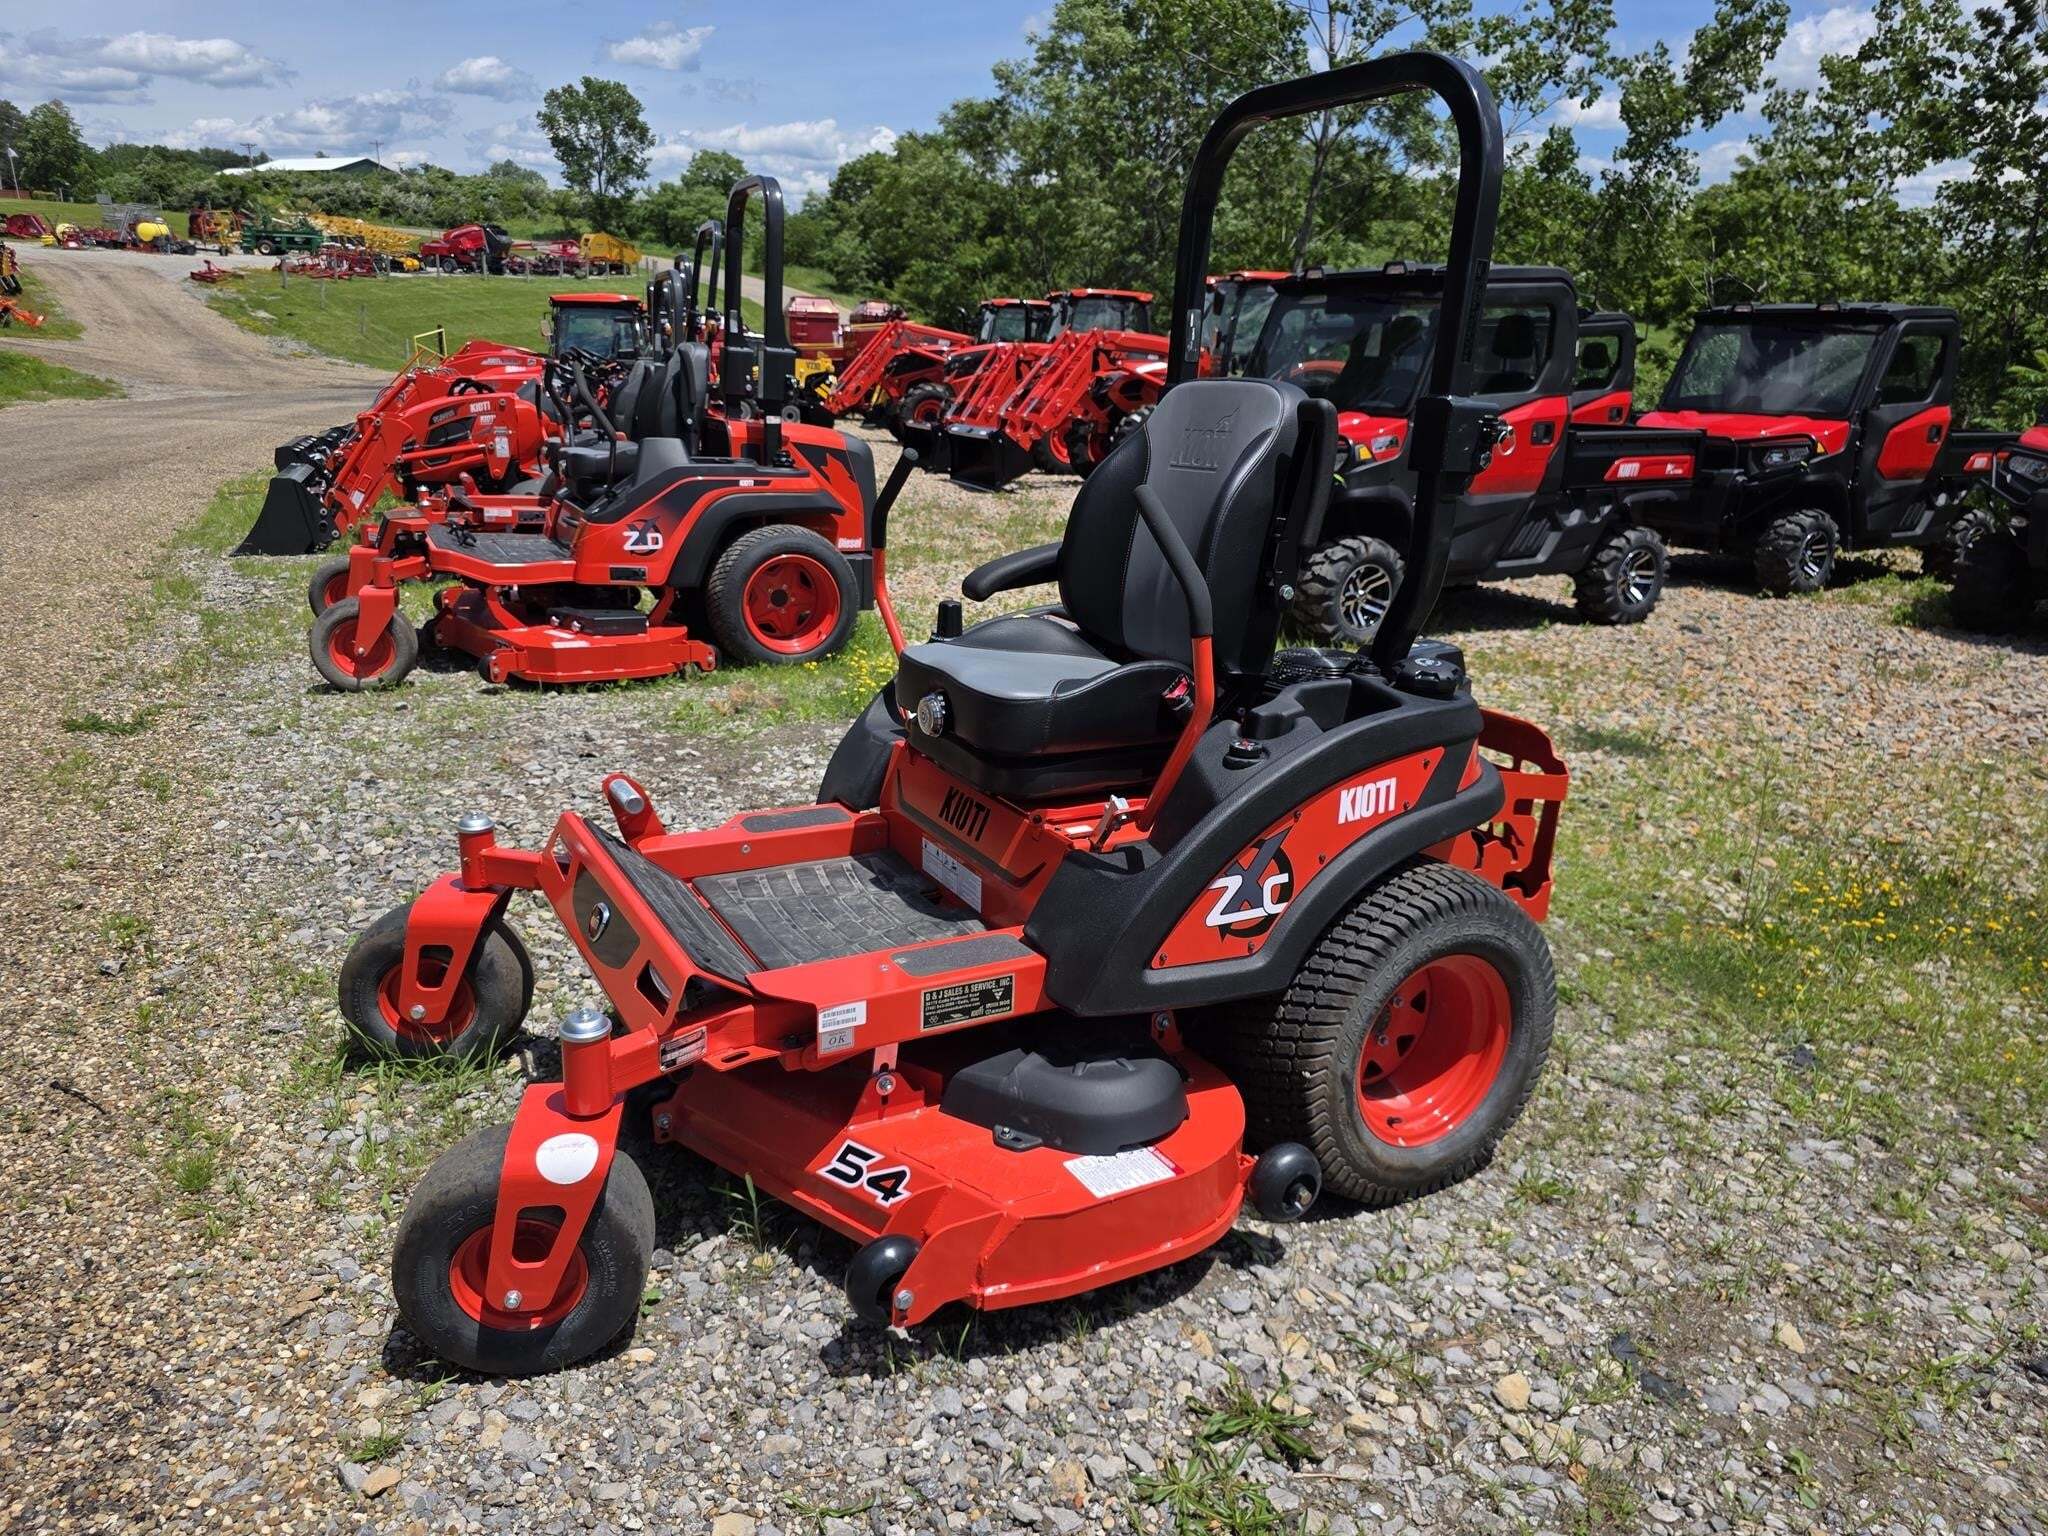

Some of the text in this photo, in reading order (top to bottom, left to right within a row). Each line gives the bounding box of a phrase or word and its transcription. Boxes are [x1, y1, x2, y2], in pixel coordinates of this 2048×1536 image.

[938, 785, 991, 842] KIOTI
[1338, 777, 1397, 825] KIOTI
[944, 987, 963, 998] SALES
[964, 985, 970, 994] &
[820, 1141, 908, 1206] 54
